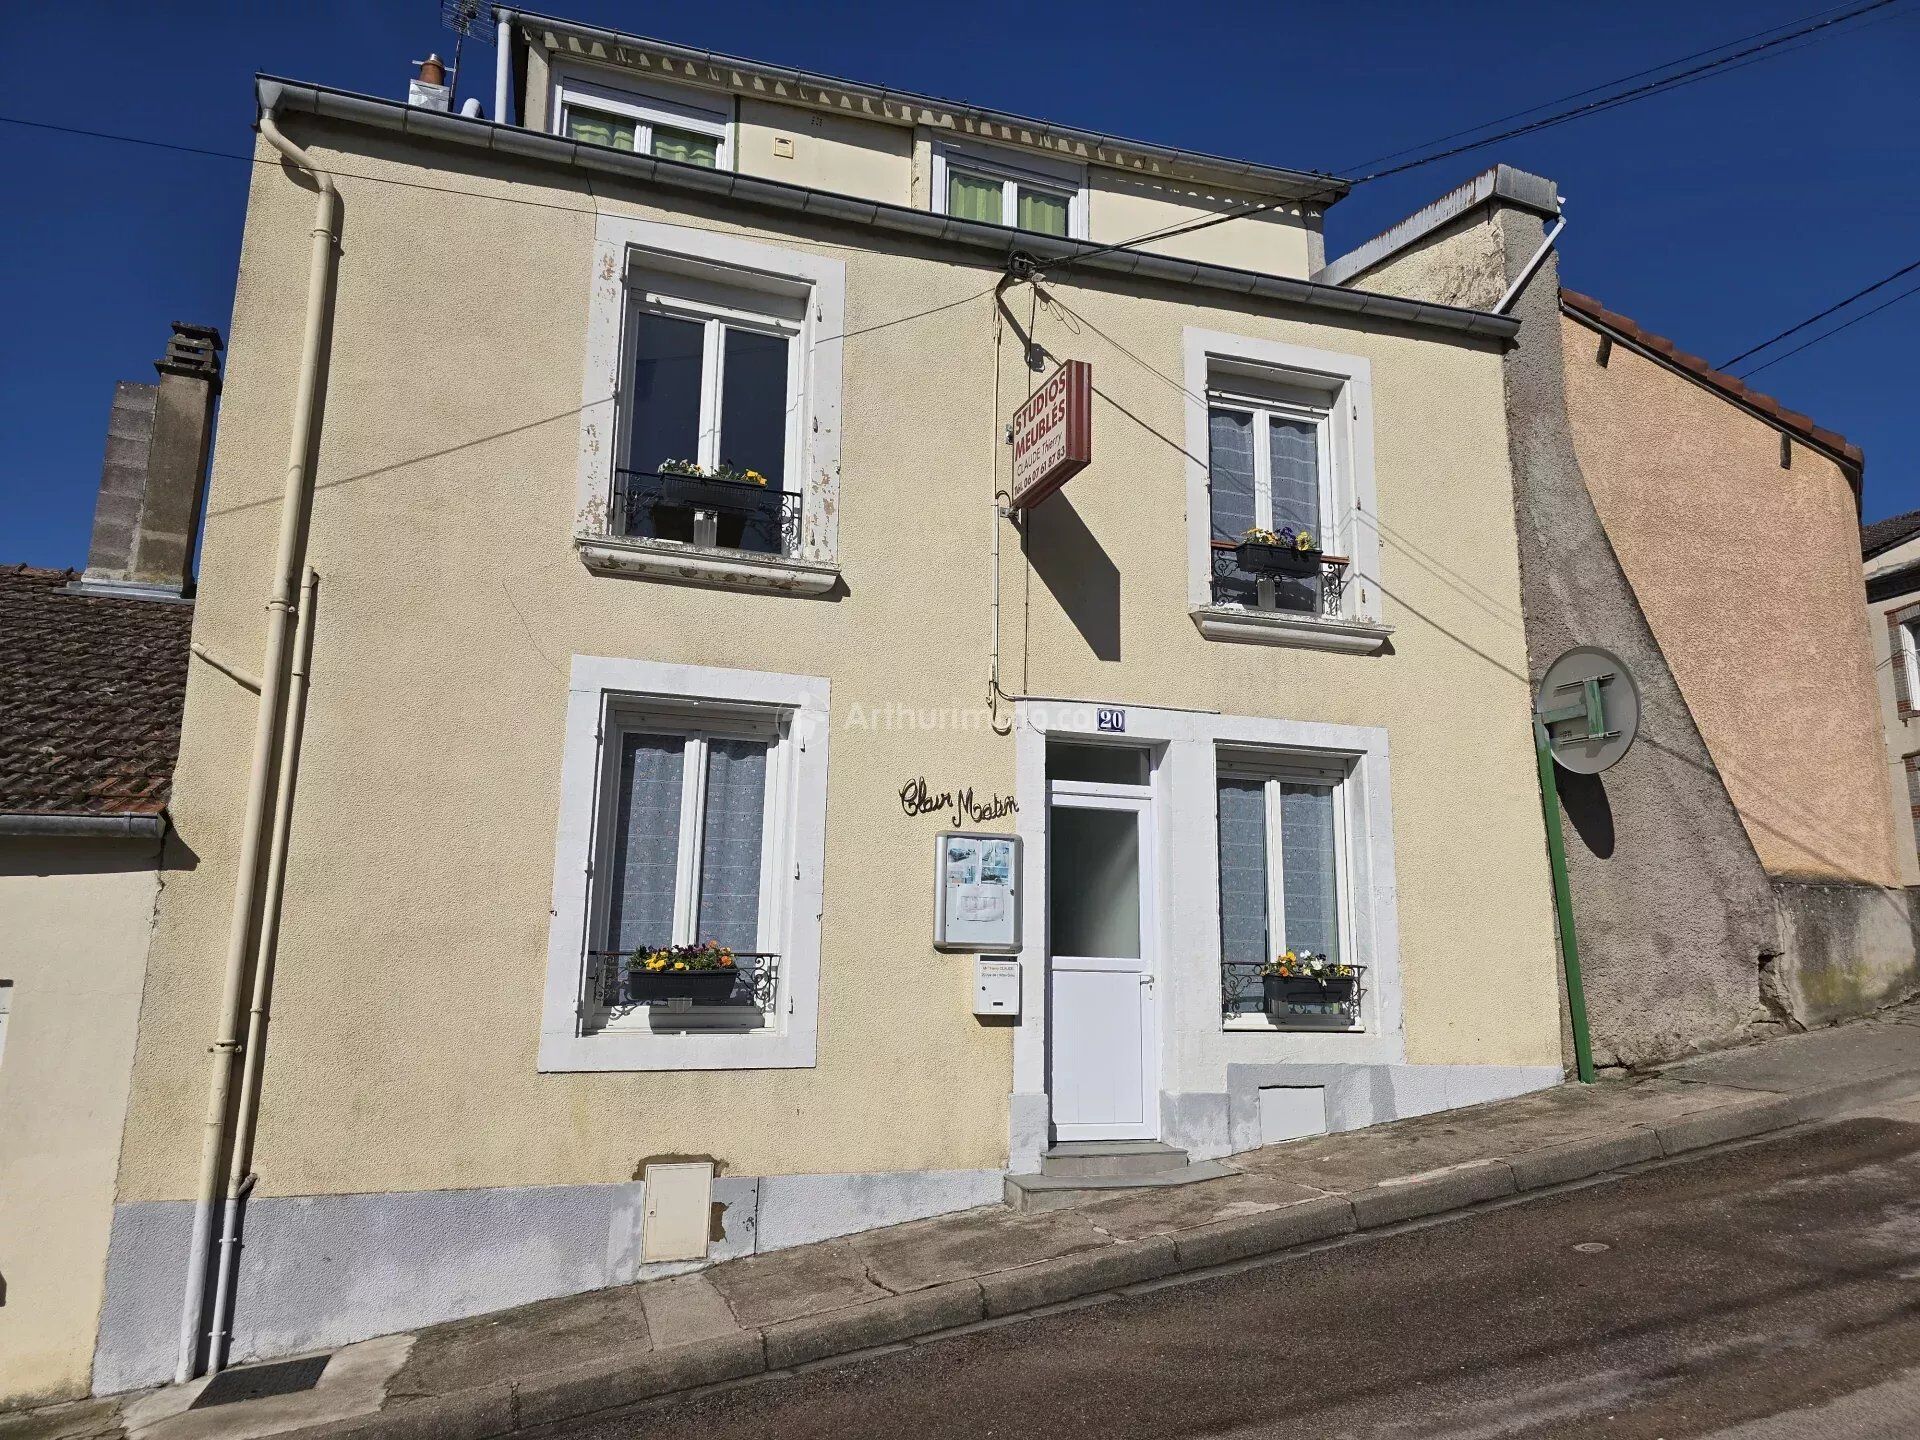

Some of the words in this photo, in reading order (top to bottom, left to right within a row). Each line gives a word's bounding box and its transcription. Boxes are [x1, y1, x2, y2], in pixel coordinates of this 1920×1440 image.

[1016, 371, 1065, 435] STUDIOS
[1015, 399, 1065, 461] MEUBLÉS
[1017, 447, 1041, 477] CLAUDE
[1024, 475, 1032, 488] 06
[1032, 466, 1040, 481] 07
[1040, 461, 1047, 475] 61
[1100, 710, 1123, 729] 20
[898, 775, 954, 817] Clair
[952, 786, 1020, 828] Matin
